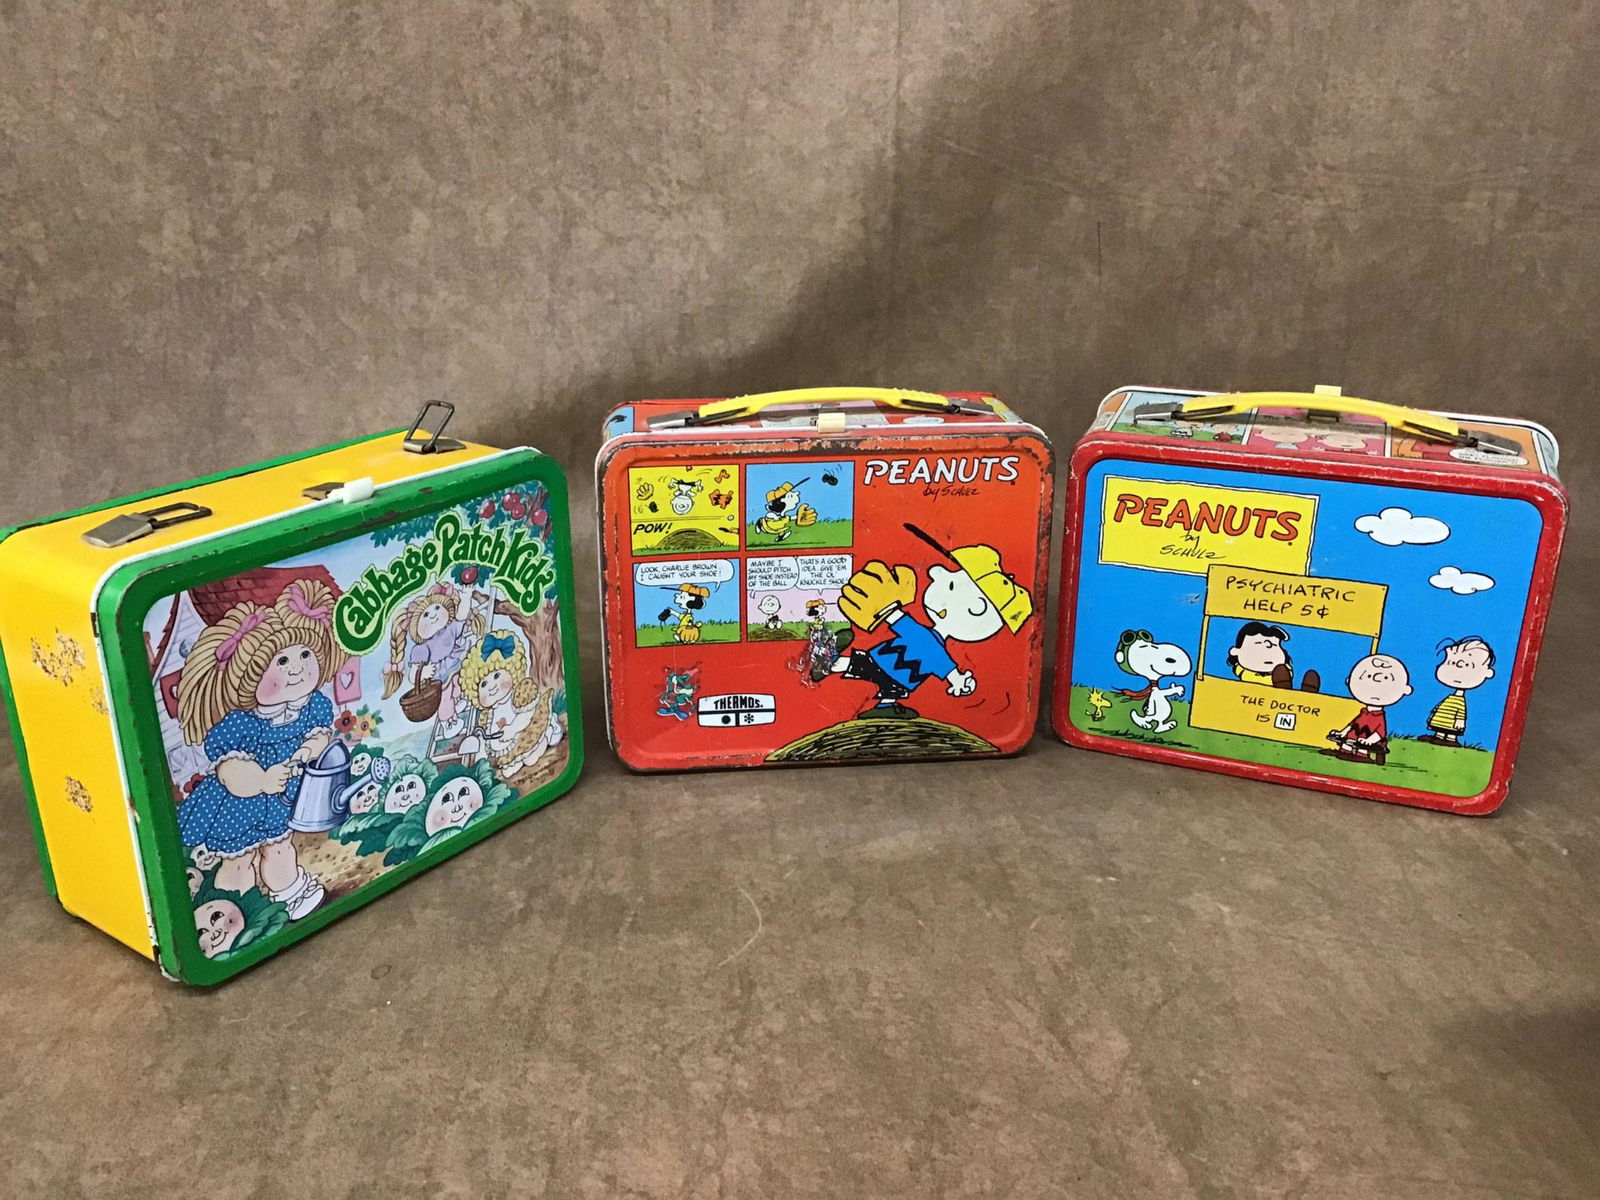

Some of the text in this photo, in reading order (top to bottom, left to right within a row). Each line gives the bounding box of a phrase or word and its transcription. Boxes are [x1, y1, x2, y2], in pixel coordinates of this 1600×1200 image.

[863, 456, 1020, 485] PEANUTS
[923, 484, 939, 502] by
[1113, 493, 1302, 542] PEANUTS
[633, 522, 673, 535] POW!
[1180, 510, 1200, 549] by
[662, 564, 690, 572] CHARLIE
[778, 559, 782, 567] I
[335, 514, 554, 652] Cabbage Patch Kids
[640, 570, 722, 582] I CAUGHT YOUR SHOE!
[748, 573, 758, 581] MY
[800, 578, 826, 586] KNUCKLE
[1225, 575, 1356, 603] PSYCHIATRIC
[1243, 599, 1330, 619] HELP 5¢
[714, 695, 761, 710] THERMOS
[1240, 695, 1321, 717] THE DOCTOR
[1256, 713, 1292, 727] IS IN
